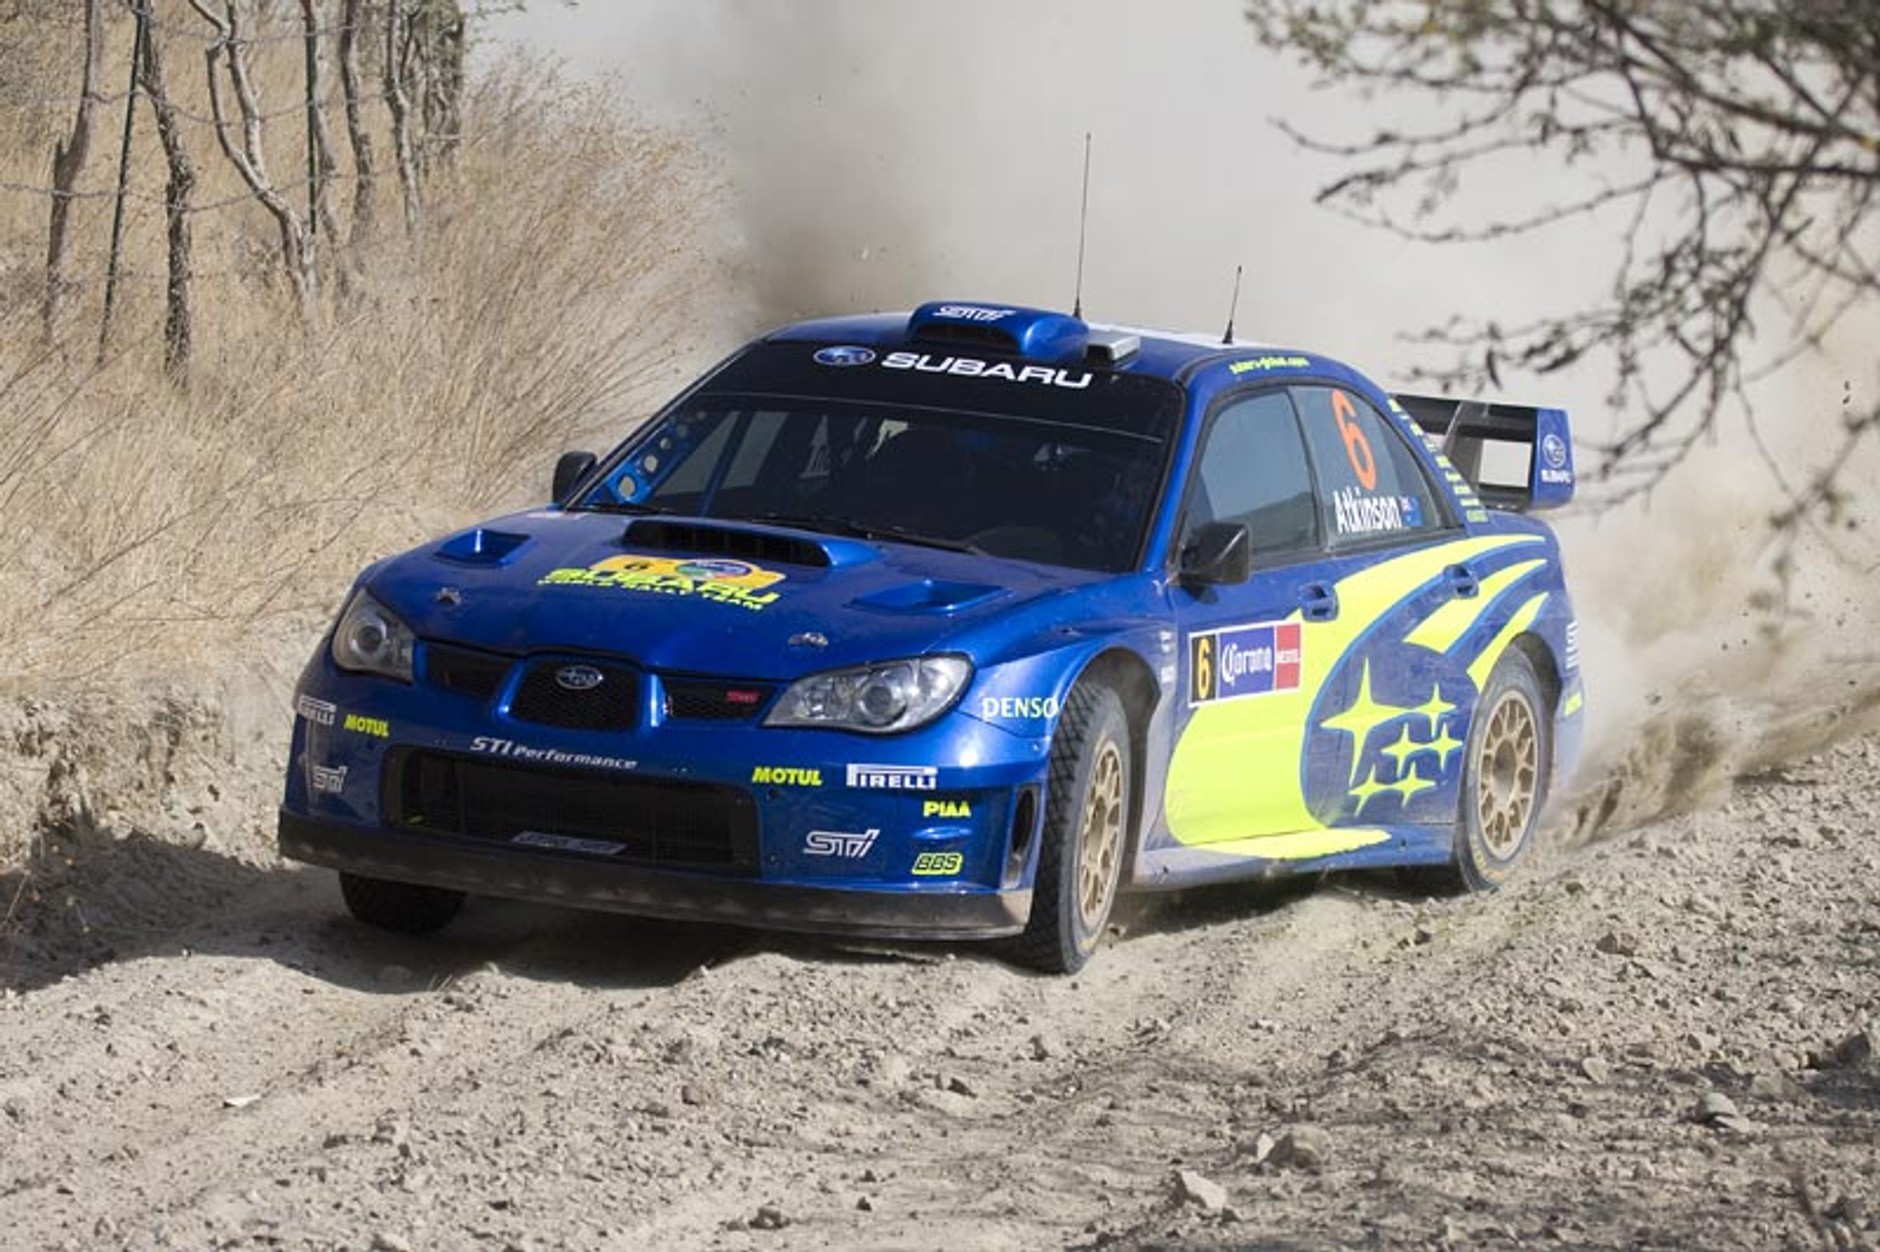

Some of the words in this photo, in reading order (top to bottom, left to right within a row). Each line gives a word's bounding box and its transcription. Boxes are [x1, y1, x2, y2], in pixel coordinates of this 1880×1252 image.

[881, 351, 1093, 389] SUBARU
[1330, 388, 1377, 490] 6
[1332, 484, 1402, 535] Atkinson
[1197, 637, 1211, 700] 6
[1221, 642, 1274, 687] Corona
[982, 697, 1060, 719] DENSO
[343, 713, 391, 738] MOTUL
[513, 745, 638, 770] Performance
[752, 766, 823, 787] MOTUL
[846, 763, 938, 789] PIRELLI
[923, 801, 972, 818] PIAA
[914, 853, 960, 871] BBS
